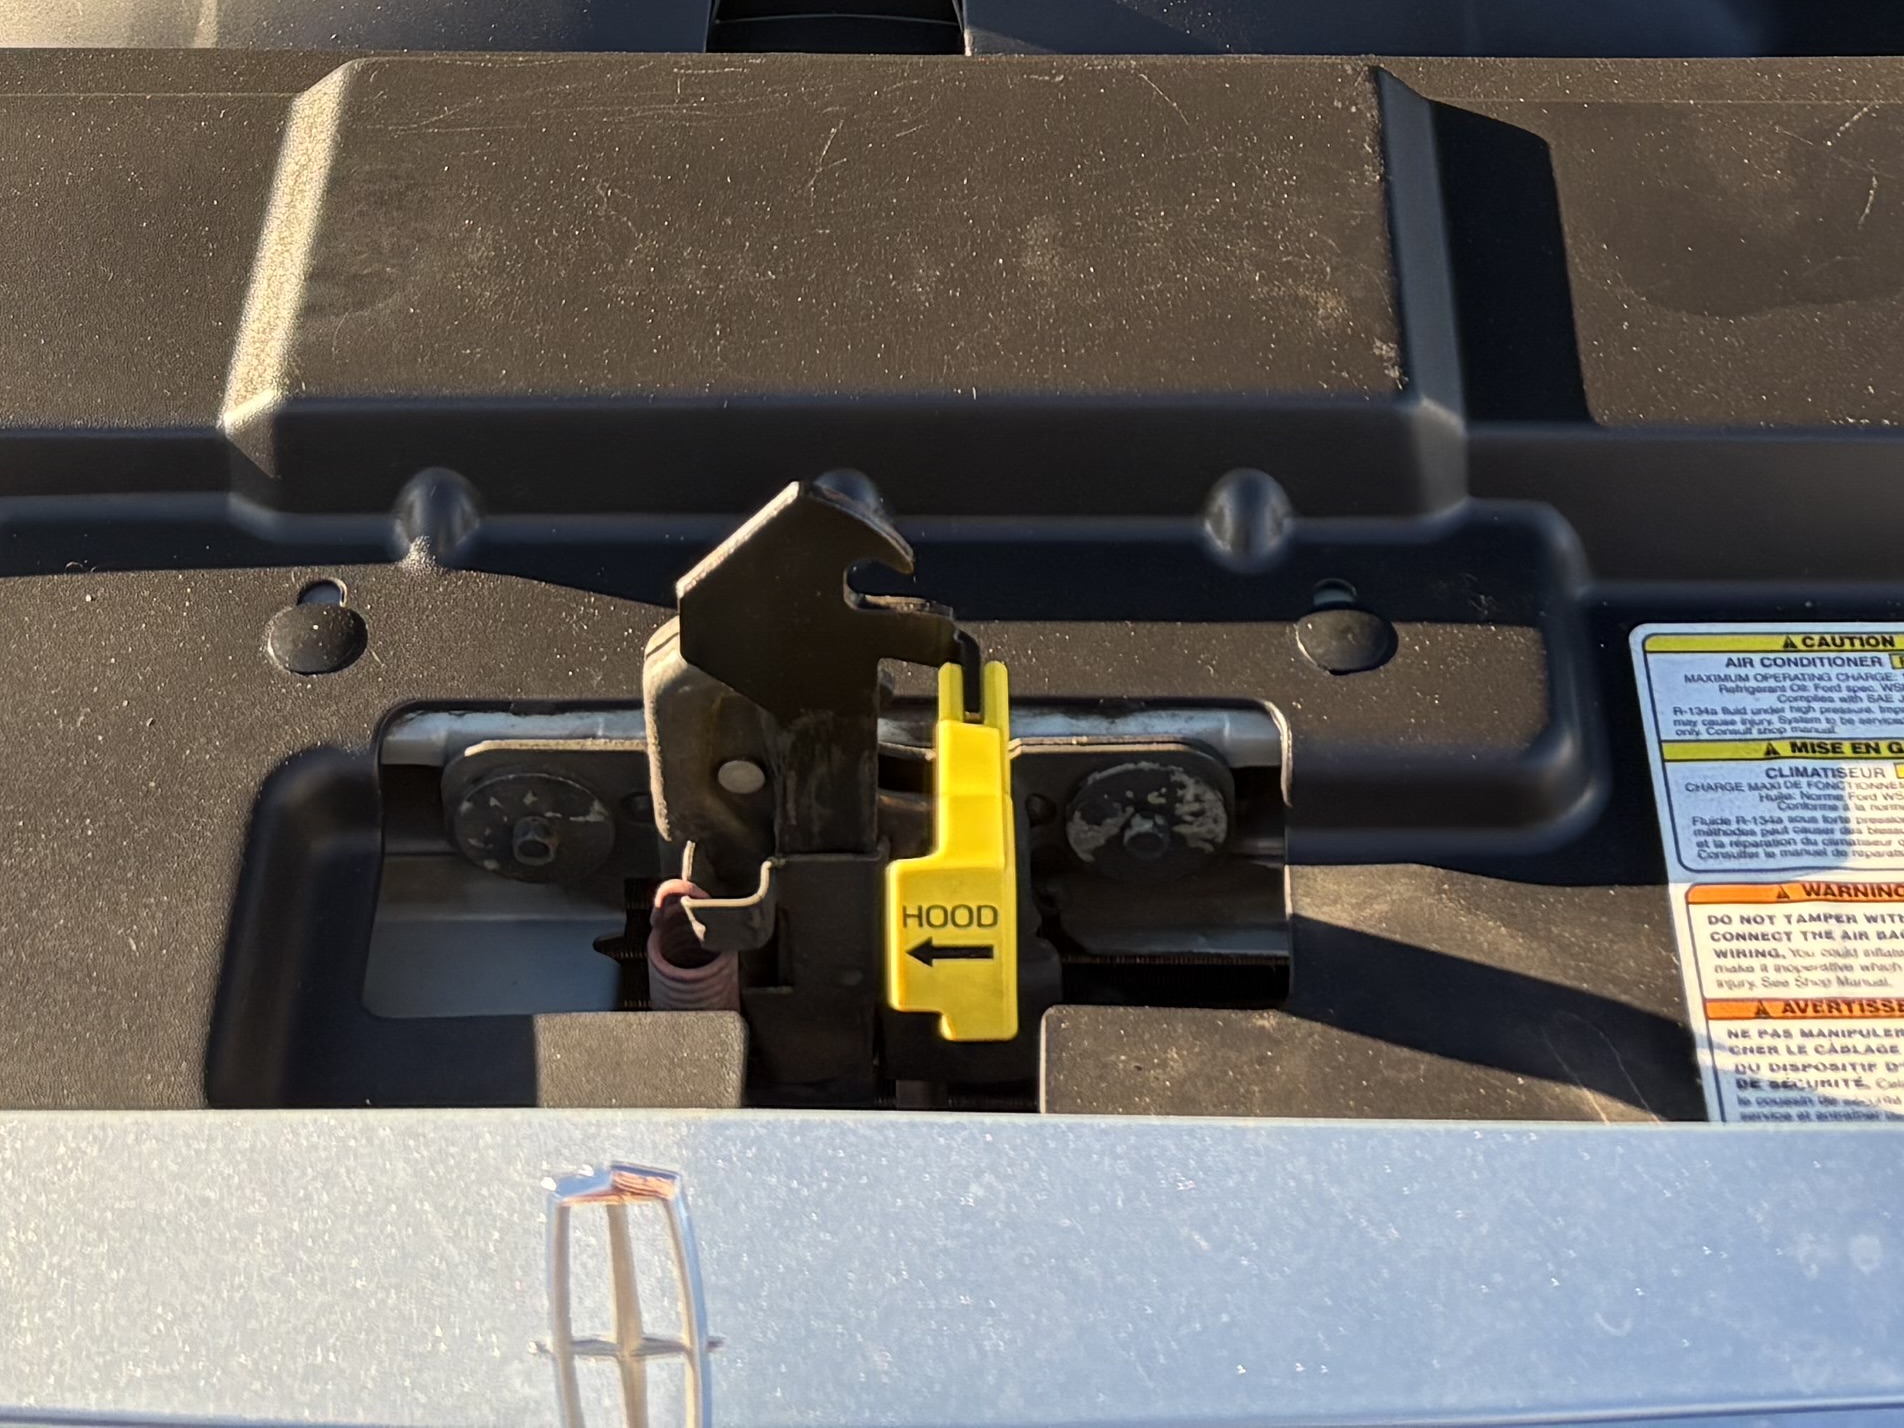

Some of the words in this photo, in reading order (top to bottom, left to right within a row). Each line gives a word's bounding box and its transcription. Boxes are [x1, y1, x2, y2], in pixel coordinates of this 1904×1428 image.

[1801, 635, 1896, 650] CAUTION
[1725, 657, 1756, 669] AIR
[1760, 655, 1884, 669] CONDITIONER
[1684, 673, 1751, 684] MAXIMUM
[1754, 673, 1833, 685] OPERATING
[1719, 684, 1787, 696] Refrigerant
[1814, 683, 1843, 693] Ford
[1777, 695, 1835, 705] Complies
[1839, 694, 1864, 704] with
[1866, 694, 1896, 704] SAE
[1790, 741, 1845, 755] MISE
[1850, 741, 1882, 754] EN
[1764, 766, 1886, 781] CLIMATISEUR
[1684, 781, 1746, 794] CHARGE
[1784, 780, 1804, 792] DE
[901, 902, 1000, 930] HOOD
[1706, 914, 1733, 926] DO
[1739, 913, 1777, 926] NOT
[1785, 912, 1858, 926] TAMPER
[1708, 930, 1794, 943] CONNECT
[1799, 930, 1835, 942] THE
[1840, 929, 1871, 941] AIR
